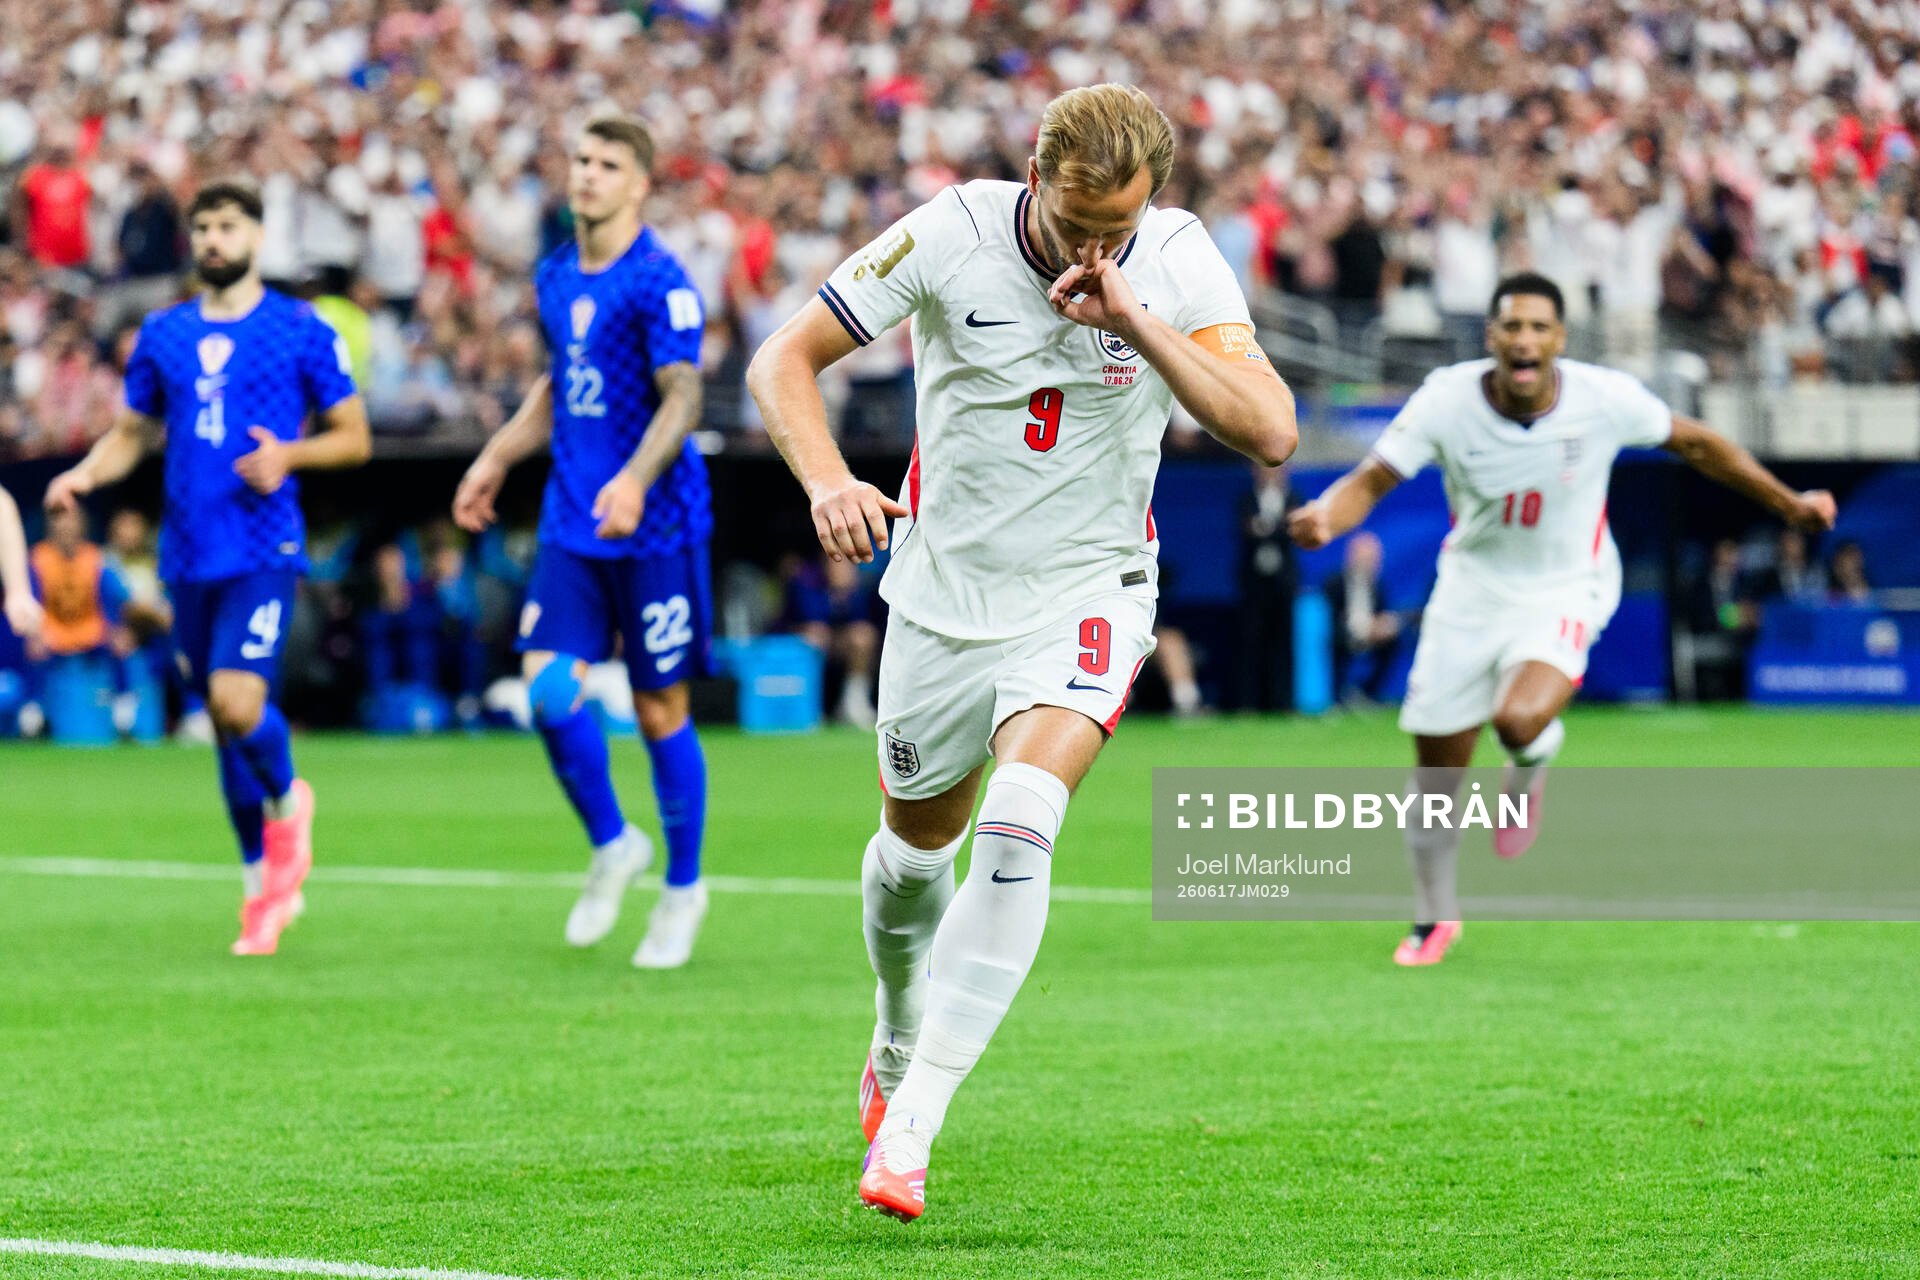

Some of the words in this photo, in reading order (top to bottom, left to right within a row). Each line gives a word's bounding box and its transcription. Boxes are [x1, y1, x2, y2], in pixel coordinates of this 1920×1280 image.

[566, 366, 607, 417] 22
[1102, 365, 1137, 374] CROATIA
[1104, 376, 1134, 385] 17.06.26
[195, 397, 226, 449] 4
[1024, 387, 1064, 452] 9
[1503, 490, 1543, 528] 10
[248, 599, 282, 643] 4
[641, 594, 693, 655] 22
[1559, 617, 1587, 652] 10
[1078, 617, 1111, 676] 9
